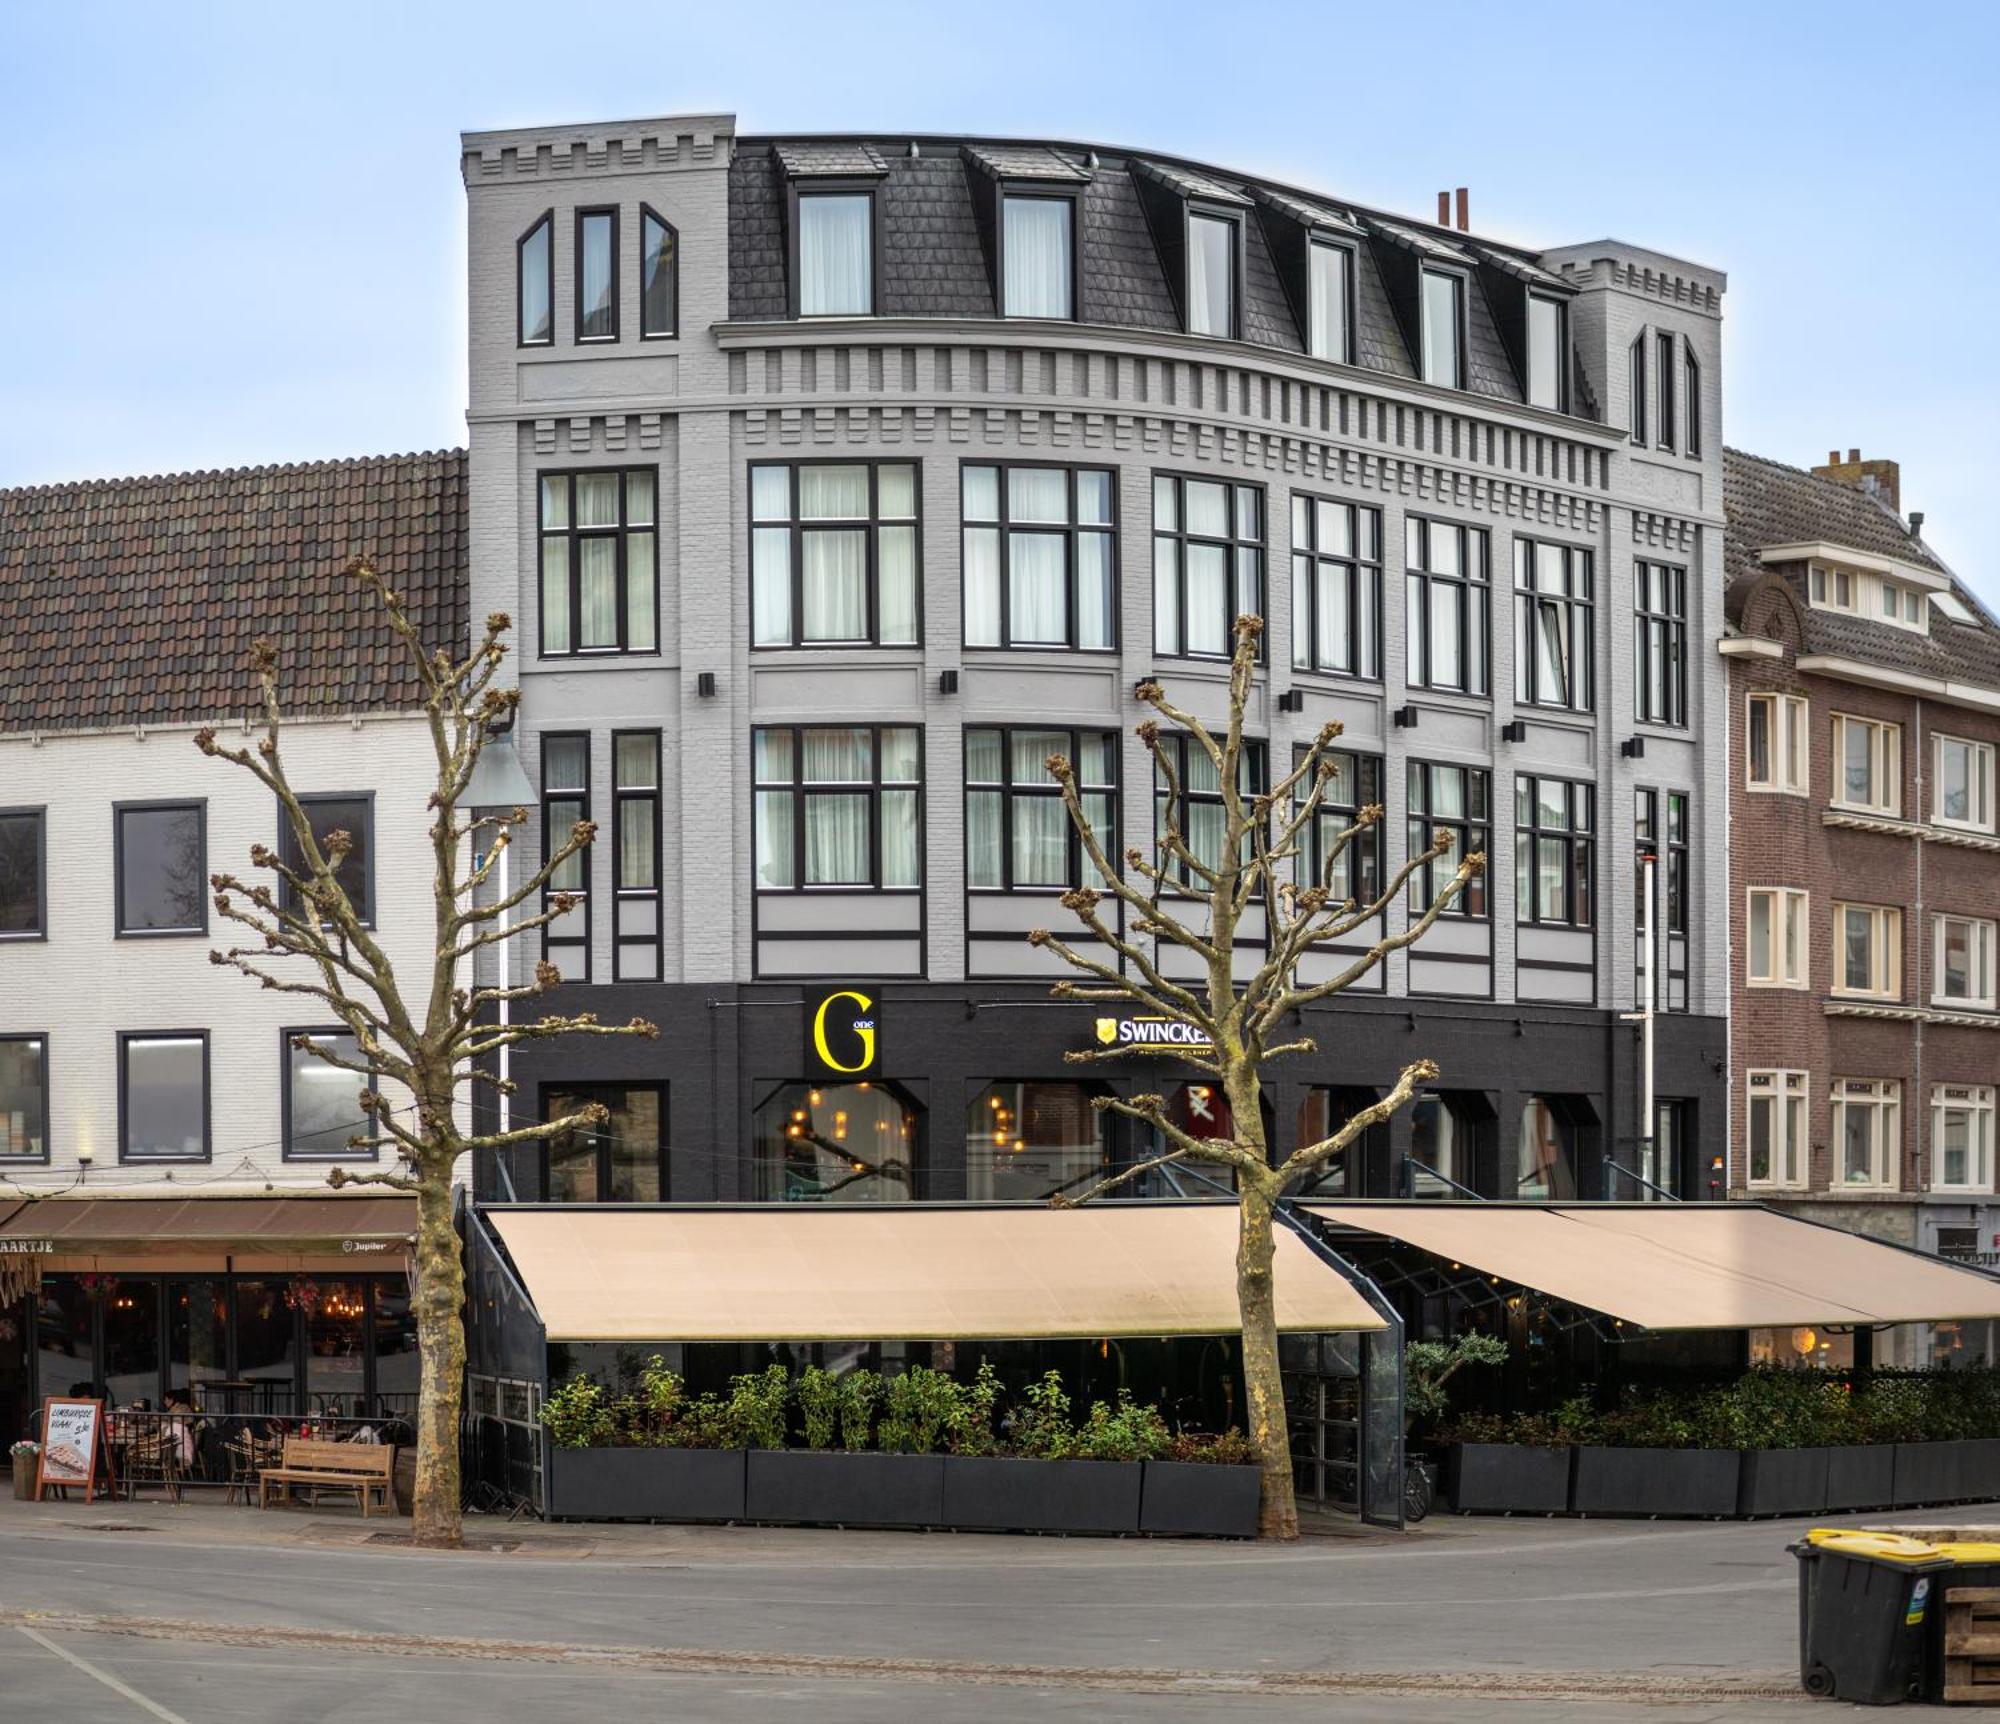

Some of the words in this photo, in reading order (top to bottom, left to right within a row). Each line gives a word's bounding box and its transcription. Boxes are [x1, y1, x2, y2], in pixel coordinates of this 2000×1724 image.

[853, 1020, 874, 1029] one
[814, 991, 873, 1072] G
[354, 1242, 386, 1252] Jupiler
